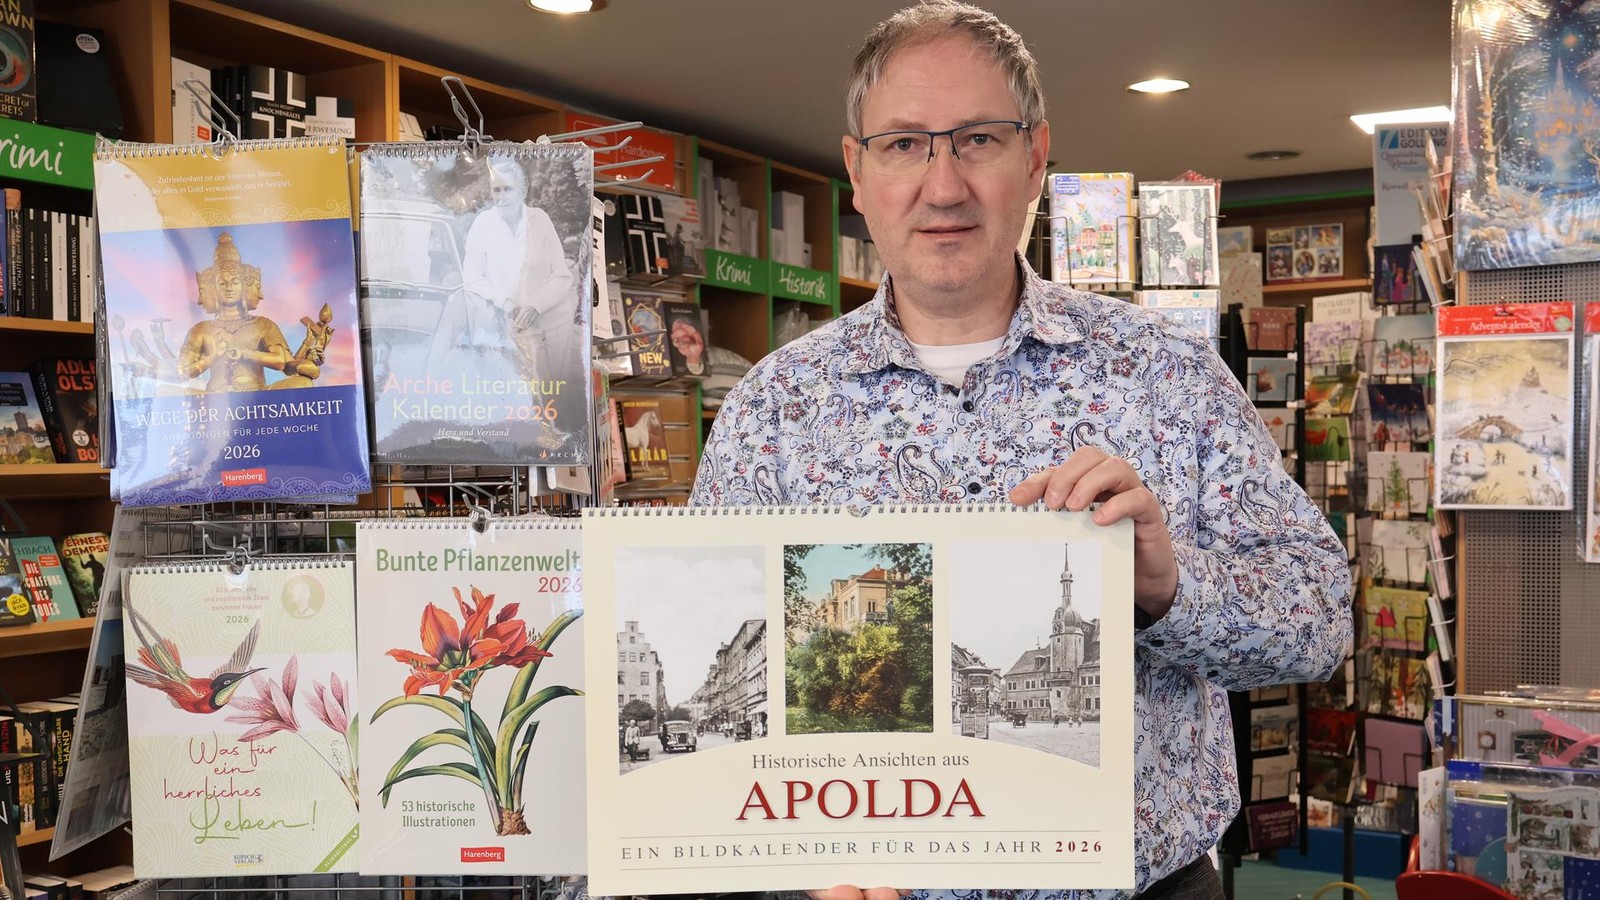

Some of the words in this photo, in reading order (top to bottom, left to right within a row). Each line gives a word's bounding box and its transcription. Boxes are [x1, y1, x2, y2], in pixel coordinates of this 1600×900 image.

[1, 104, 23, 116] RETS
[1400, 128, 1448, 138] EDITON
[1400, 138, 1448, 149] GOLLNG
[158, 176, 204, 184] Zufriedenheit
[188, 184, 204, 193] Gold
[715, 255, 751, 286] Krimi
[779, 267, 827, 299] Historik
[1469, 319, 1541, 331] Adventskalender
[639, 352, 663, 364] NEW
[58, 375, 96, 391] OLS
[382, 373, 454, 396] Arche
[461, 372, 567, 396] Literatur
[136, 410, 182, 427] WEGE
[187, 408, 219, 424] DER
[224, 400, 343, 421] ACHTSAMKEIT
[393, 399, 498, 421] Kalender
[505, 399, 559, 422] 2026
[234, 427, 252, 437] FÜR
[255, 426, 280, 436] JEDE
[283, 424, 319, 434] WOCHE
[437, 427, 458, 438] Herz
[459, 427, 475, 437] und
[476, 427, 510, 437] Verstand
[224, 445, 261, 460] 2026
[550, 451, 589, 459] ARCH
[224, 471, 264, 483] Harenberg
[65, 536, 108, 548] ERNEST
[375, 548, 438, 572] Bunte
[443, 547, 582, 572] Pflanzenwelt
[25, 562, 40, 574] DIE
[538, 577, 583, 594] 2026
[34, 589, 50, 602] DES
[31, 602, 61, 618] TODES
[226, 615, 249, 624] 2026
[62, 729, 72, 762] HAND
[189, 730, 240, 764] Was
[250, 741, 278, 767] für
[752, 753, 848, 770] Historische
[853, 751, 937, 769] Ansichten
[942, 755, 970, 768] aus
[214, 762, 256, 775] ein
[164, 776, 262, 800] herrliches
[401, 800, 415, 813] 53
[416, 799, 476, 813] historische
[735, 776, 986, 822] APOLDA
[402, 814, 476, 829] Illustrationen
[463, 849, 502, 861] Harenberg
[620, 846, 661, 861] EIN
[673, 840, 859, 859] BILDKALENDER
[871, 838, 915, 855] FÜR
[928, 840, 972, 855] DAS
[984, 840, 1043, 854] JAHR
[1055, 840, 1103, 854] 2026
